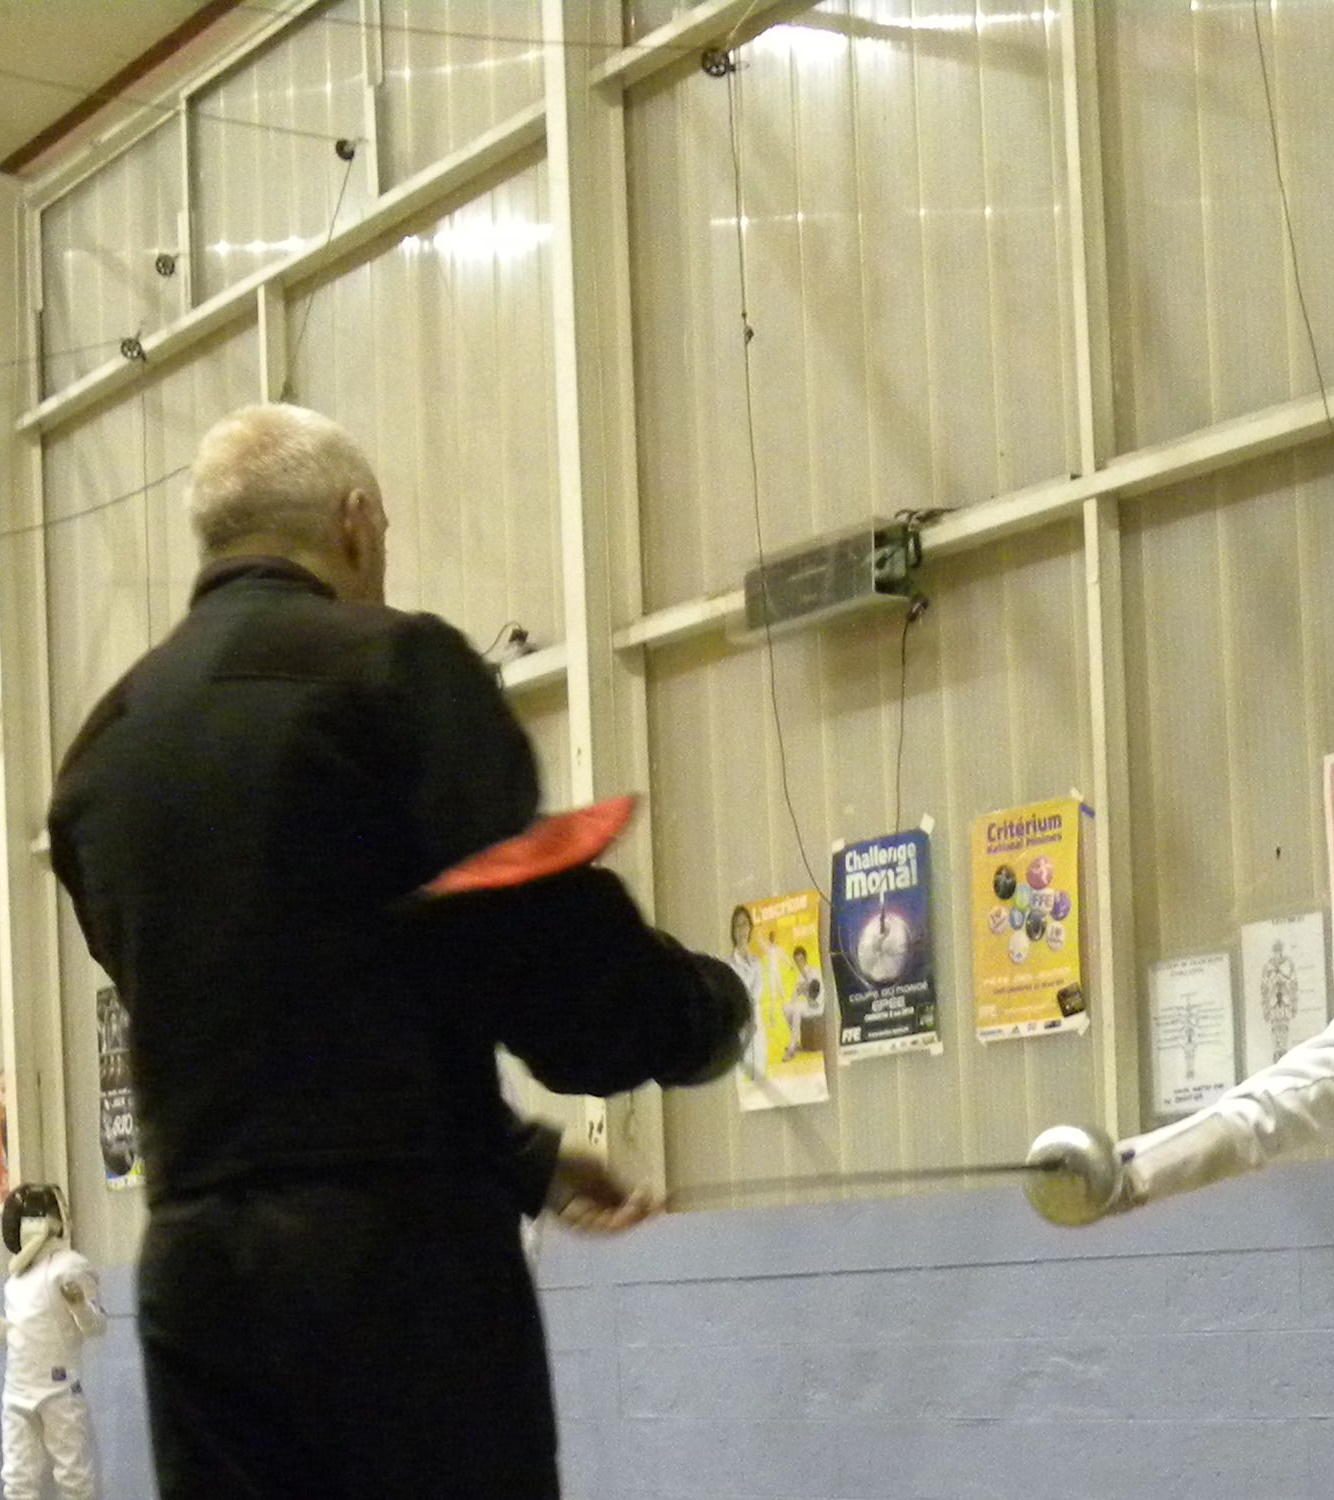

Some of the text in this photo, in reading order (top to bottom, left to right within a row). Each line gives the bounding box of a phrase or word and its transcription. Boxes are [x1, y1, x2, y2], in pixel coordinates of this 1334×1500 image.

[987, 813, 1062, 842] Critérium
[845, 842, 916, 873] Challenge
[845, 858, 918, 900] monal
